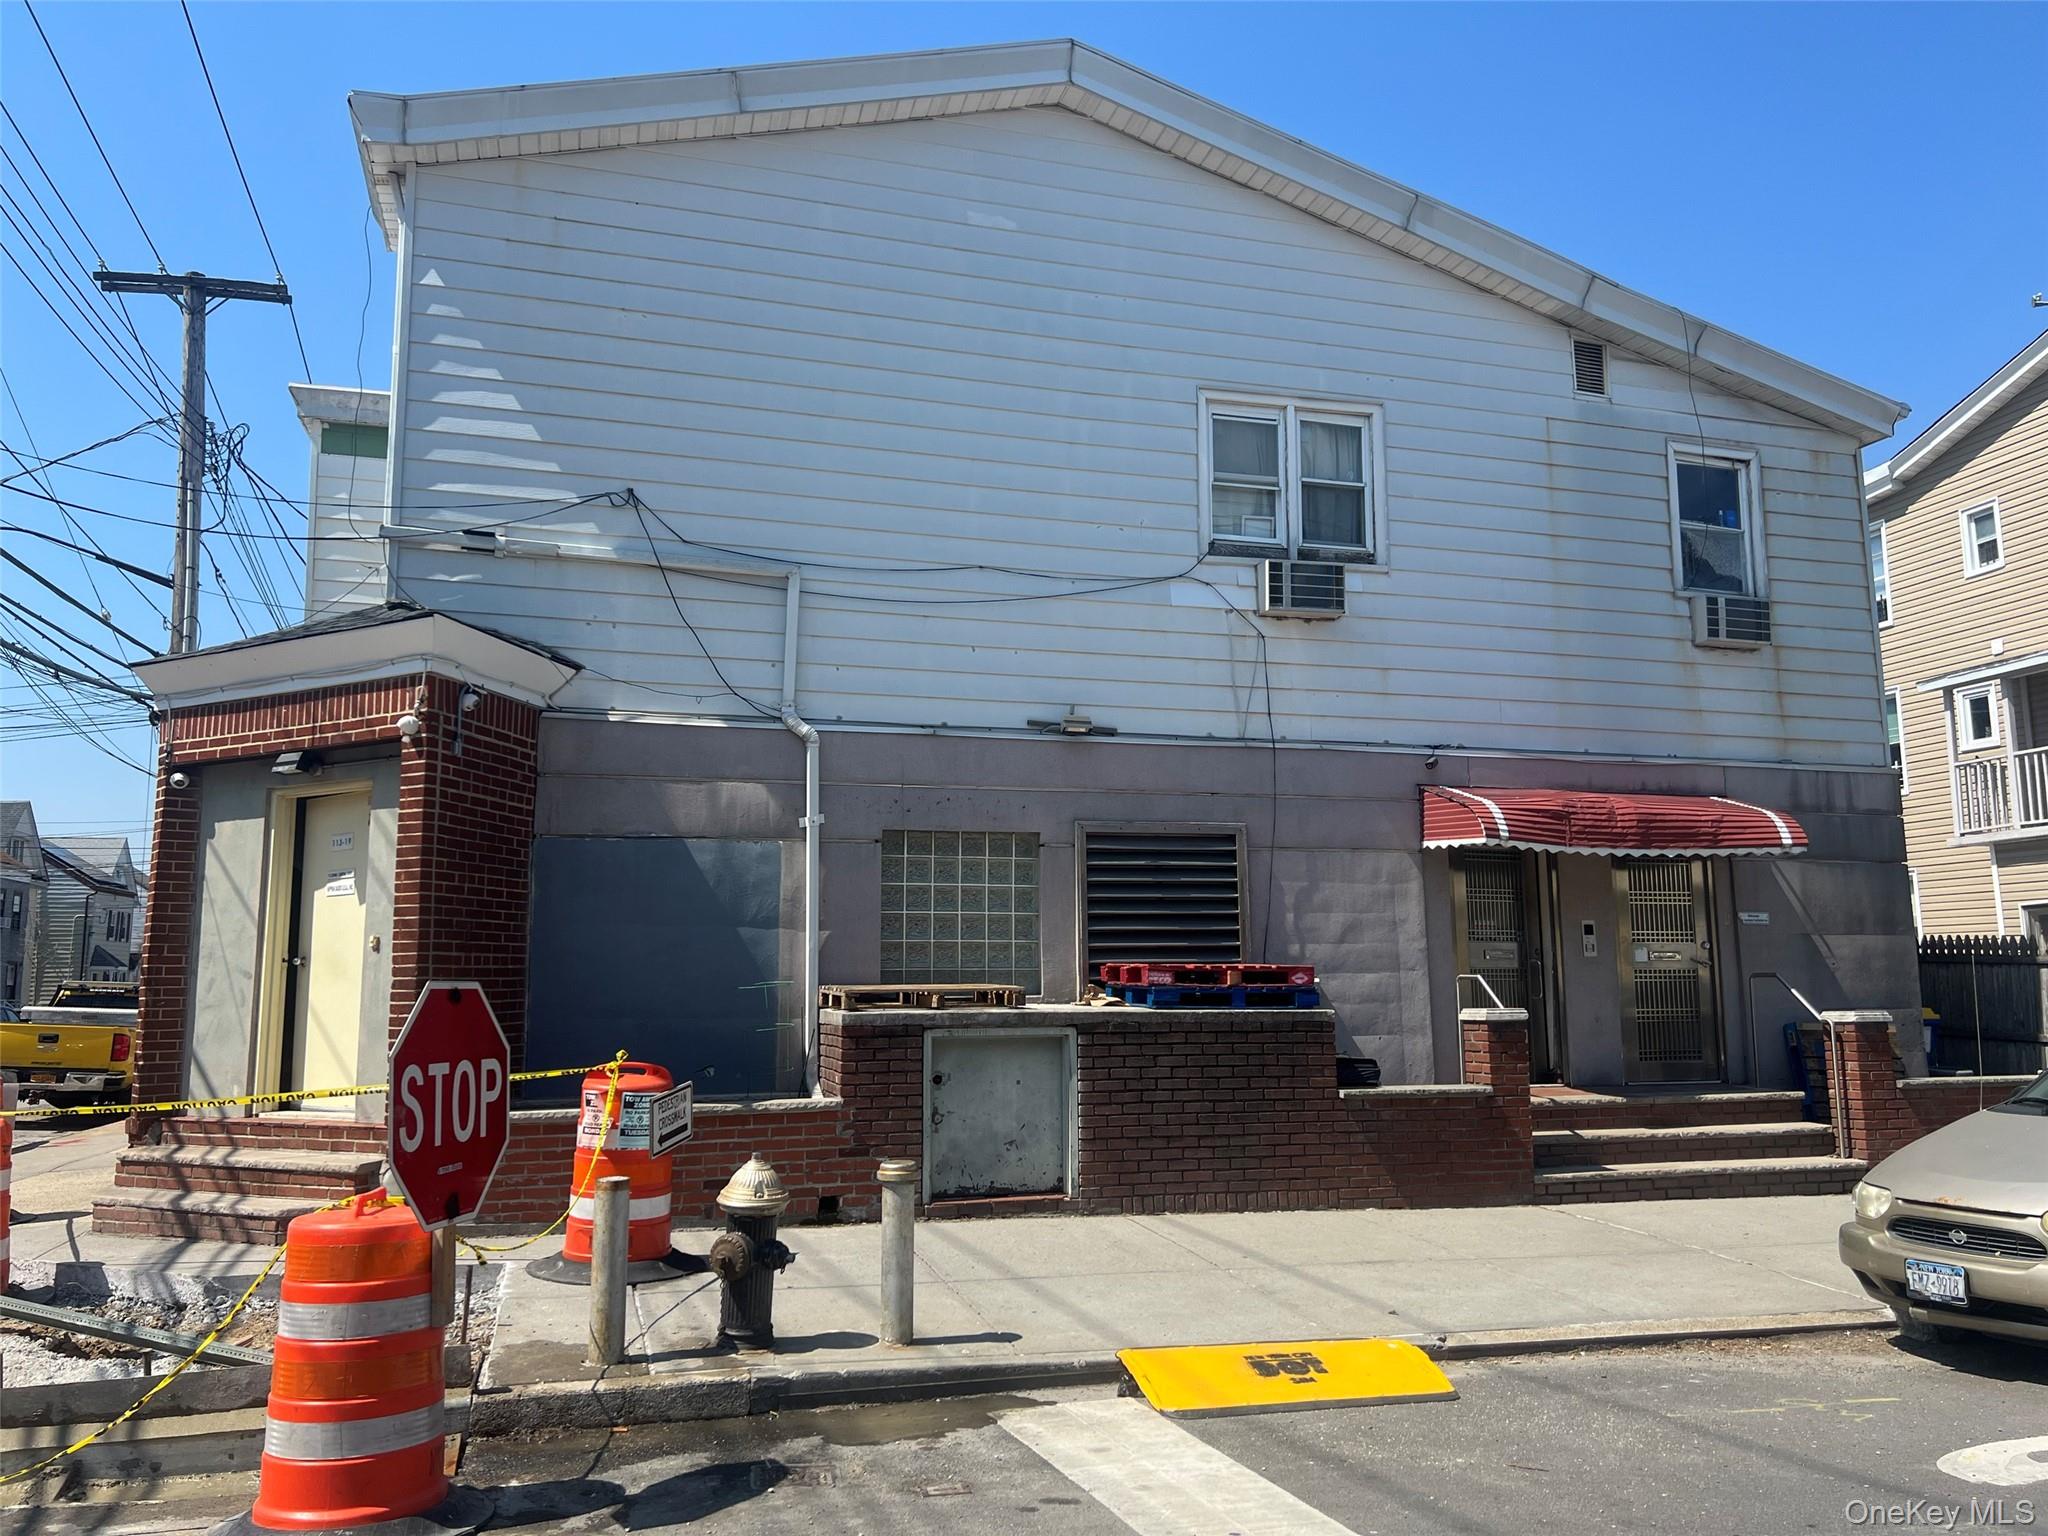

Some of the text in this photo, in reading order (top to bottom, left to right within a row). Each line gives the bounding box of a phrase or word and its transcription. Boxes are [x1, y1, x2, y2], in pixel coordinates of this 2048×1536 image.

[399, 1058, 503, 1153] STOP
[657, 1092, 687, 1114] PEDESTRIAN
[658, 1107, 687, 1130] CROSSWALK
[1248, 1358, 1328, 1377] DOT
